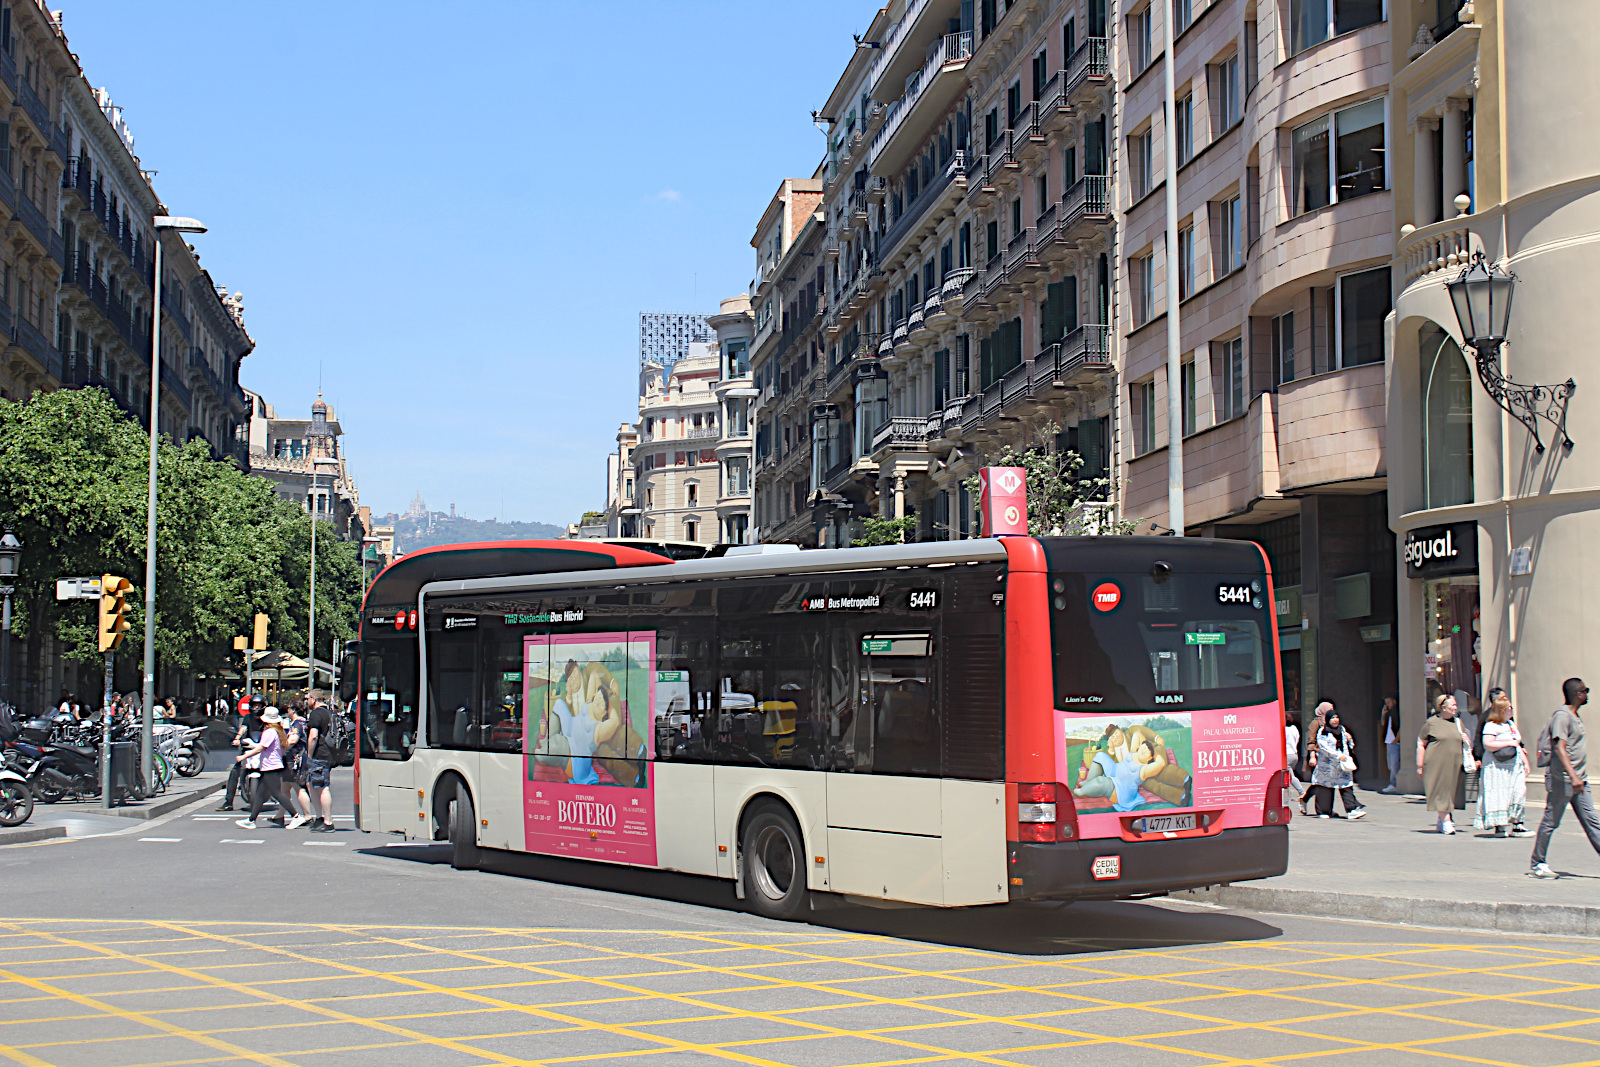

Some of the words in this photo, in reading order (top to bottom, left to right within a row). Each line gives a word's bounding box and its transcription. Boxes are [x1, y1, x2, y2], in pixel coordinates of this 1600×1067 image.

[910, 592, 936, 608] 5441
[1096, 593, 1118, 603] TMB
[1219, 586, 1251, 603] 5441
[809, 599, 825, 609] AMB
[828, 598, 840, 609] Bus
[840, 595, 880, 610] Metropolità
[410, 613, 416, 626] B
[504, 613, 518, 624] TMB
[550, 611, 563, 623] Bus
[1065, 695, 1086, 703] Lion's
[1087, 695, 1104, 704] City
[1154, 694, 1184, 704] MAN
[1203, 728, 1222, 736] PALAU
[1222, 726, 1258, 735] MARTORELL
[1197, 747, 1266, 769] BOTERO
[557, 799, 617, 828] BOTERO
[1149, 817, 1172, 831] 4777
[1175, 816, 1192, 829] KKT
[1095, 859, 1118, 868] CEDIU
[1105, 867, 1118, 875] PAS
